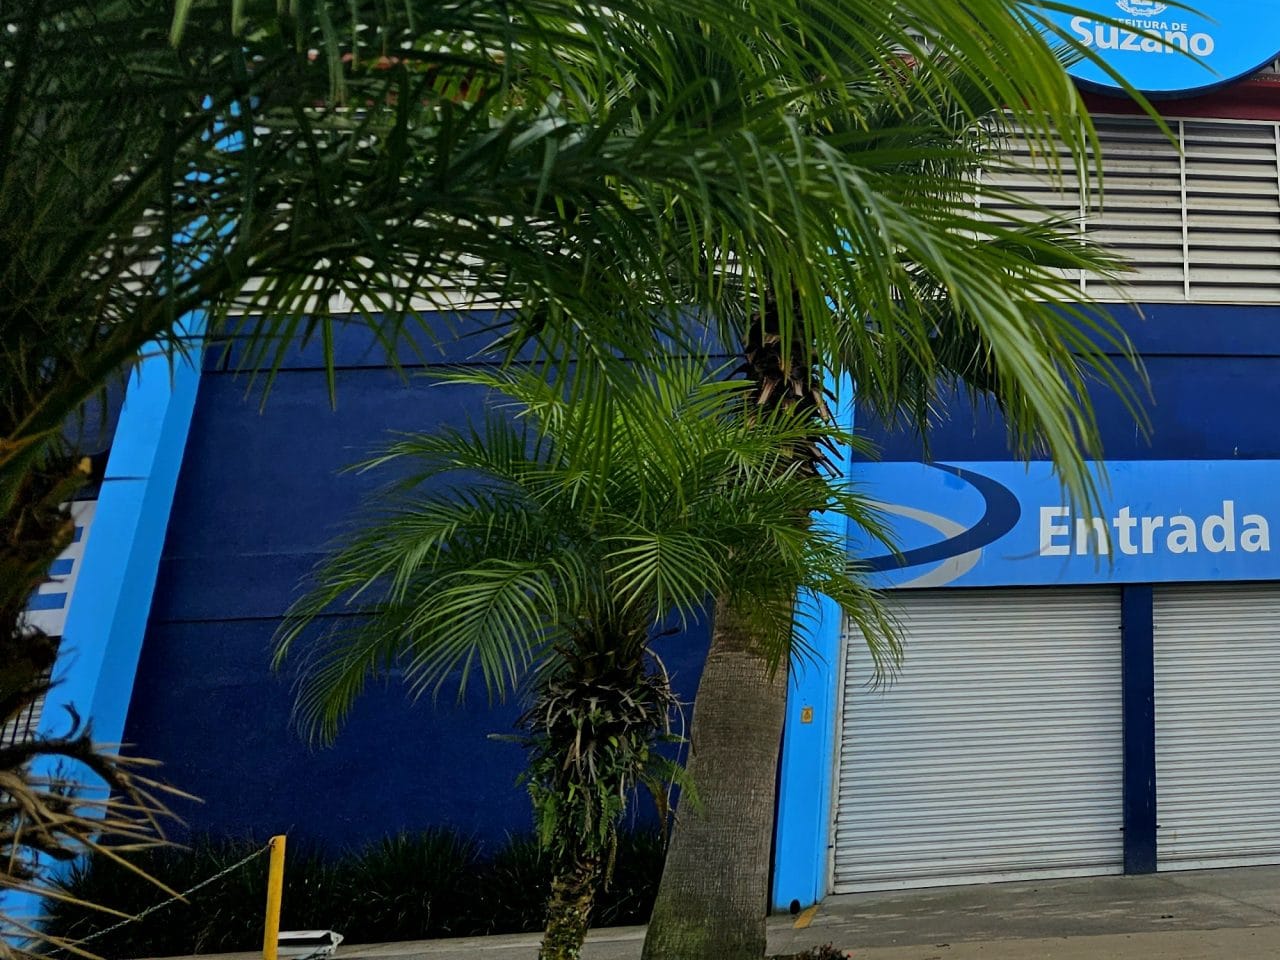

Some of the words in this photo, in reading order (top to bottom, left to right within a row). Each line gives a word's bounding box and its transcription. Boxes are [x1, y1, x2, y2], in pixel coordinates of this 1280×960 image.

[1070, 15, 1215, 57] Suzano
[1171, 22, 1188, 32] DE
[1039, 500, 1271, 556] Entrada
